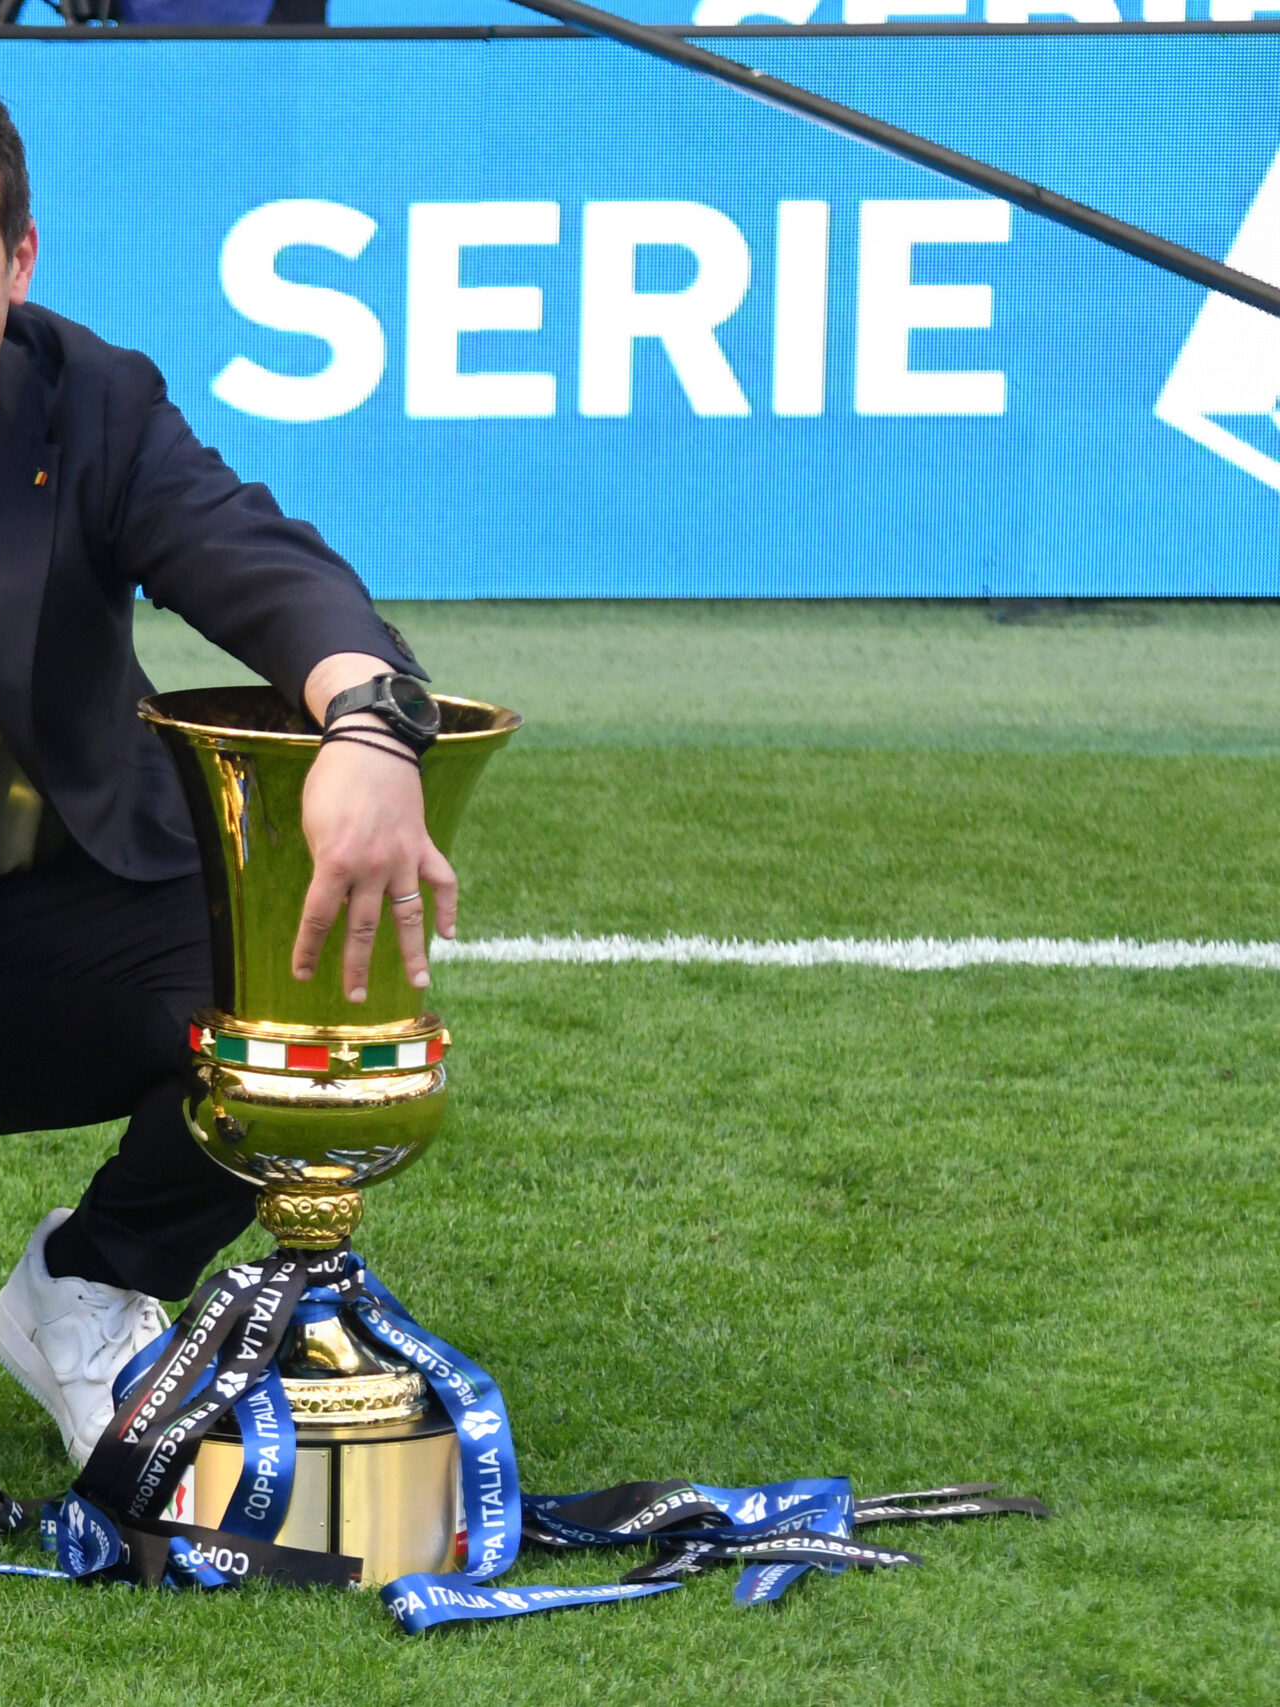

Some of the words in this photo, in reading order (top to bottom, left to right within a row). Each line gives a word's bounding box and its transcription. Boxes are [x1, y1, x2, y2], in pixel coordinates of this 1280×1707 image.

[212, 198, 1012, 423] SERIE
[237, 1287, 283, 1360] ITALIA
[123, 1290, 234, 1444] FRECCIAROSSA
[248, 1389, 280, 1438] ITALIA
[127, 1401, 220, 1518] FRECCIAROSSA
[244, 1445, 280, 1521] COPPA
[477, 1447, 505, 1528] ITALIA
[726, 1537, 910, 1564] FRECCIAROSSA
[427, 1586, 497, 1609] ITALIA
